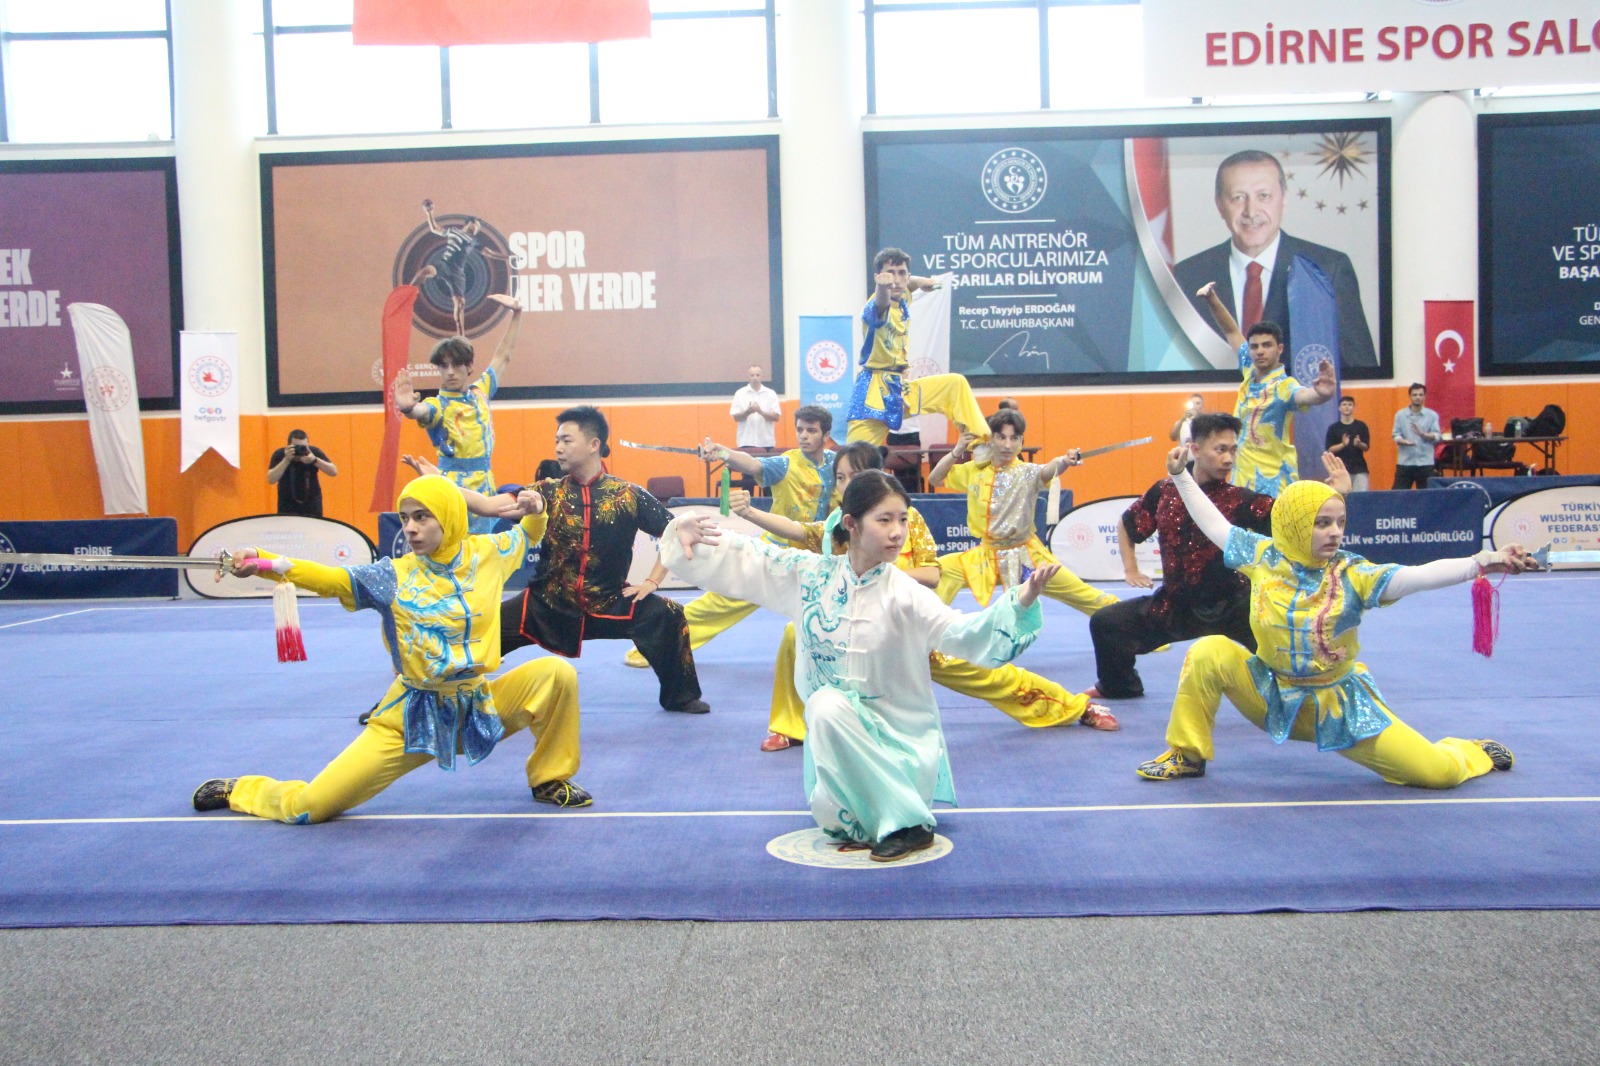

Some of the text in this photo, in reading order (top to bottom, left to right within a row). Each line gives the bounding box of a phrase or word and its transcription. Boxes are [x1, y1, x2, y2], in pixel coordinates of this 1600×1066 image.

[1205, 22, 1364, 67] EDİRNE
[1377, 24, 1493, 61] SPOR
[943, 230, 1088, 251] TÜM ANTRENÖR
[1573, 224, 1600, 242] TÜ
[509, 230, 586, 270] SPOR
[1552, 246, 1575, 261] VE
[923, 250, 1109, 270] VE SPORCULARIMIZA
[950, 270, 1103, 290] ŞARILAR DİLİYORUM
[510, 271, 657, 312] HER YERDE
[959, 301, 1075, 318] Recep Tayyip ERDOĞAN
[961, 317, 1074, 330] T.C. CUMHURBAŞKANI
[1376, 516, 1417, 529] EDİRNE
[1540, 514, 1581, 523] WUSHU
[1548, 524, 1600, 533] FEDERAS
[1362, 536, 1373, 544] ve
[1375, 534, 1399, 544] SPOR
[1401, 532, 1409, 543] İL
[1411, 530, 1474, 543] MÜDÜRLÜĞÜ
[74, 545, 113, 556] EDİRNE
[946, 542, 968, 550] SPOR
